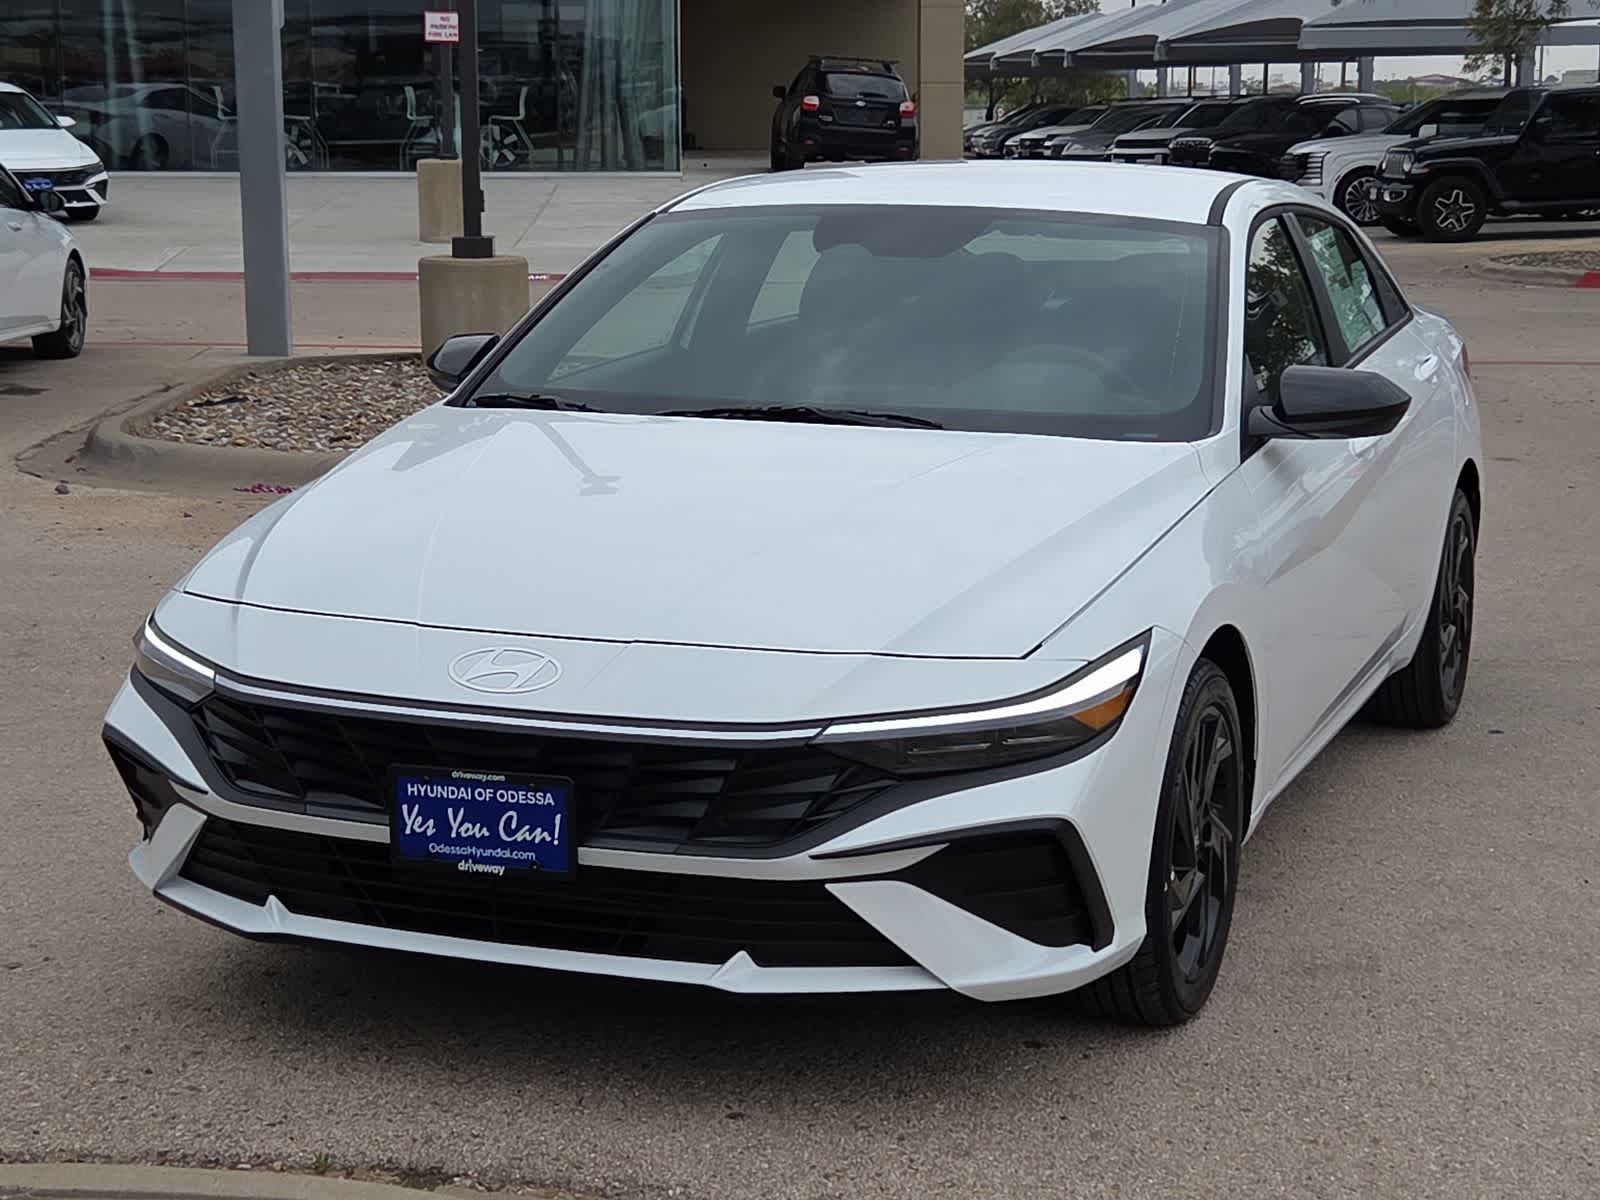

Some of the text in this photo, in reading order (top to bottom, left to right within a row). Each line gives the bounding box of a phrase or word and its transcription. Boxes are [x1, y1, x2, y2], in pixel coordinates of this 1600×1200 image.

[407, 783, 555, 806] HYUNDAI OF ODESSA
[401, 804, 562, 846] Yes You Can!
[428, 842, 536, 861] OdessaHyundai.com
[457, 859, 505, 876] driveway
